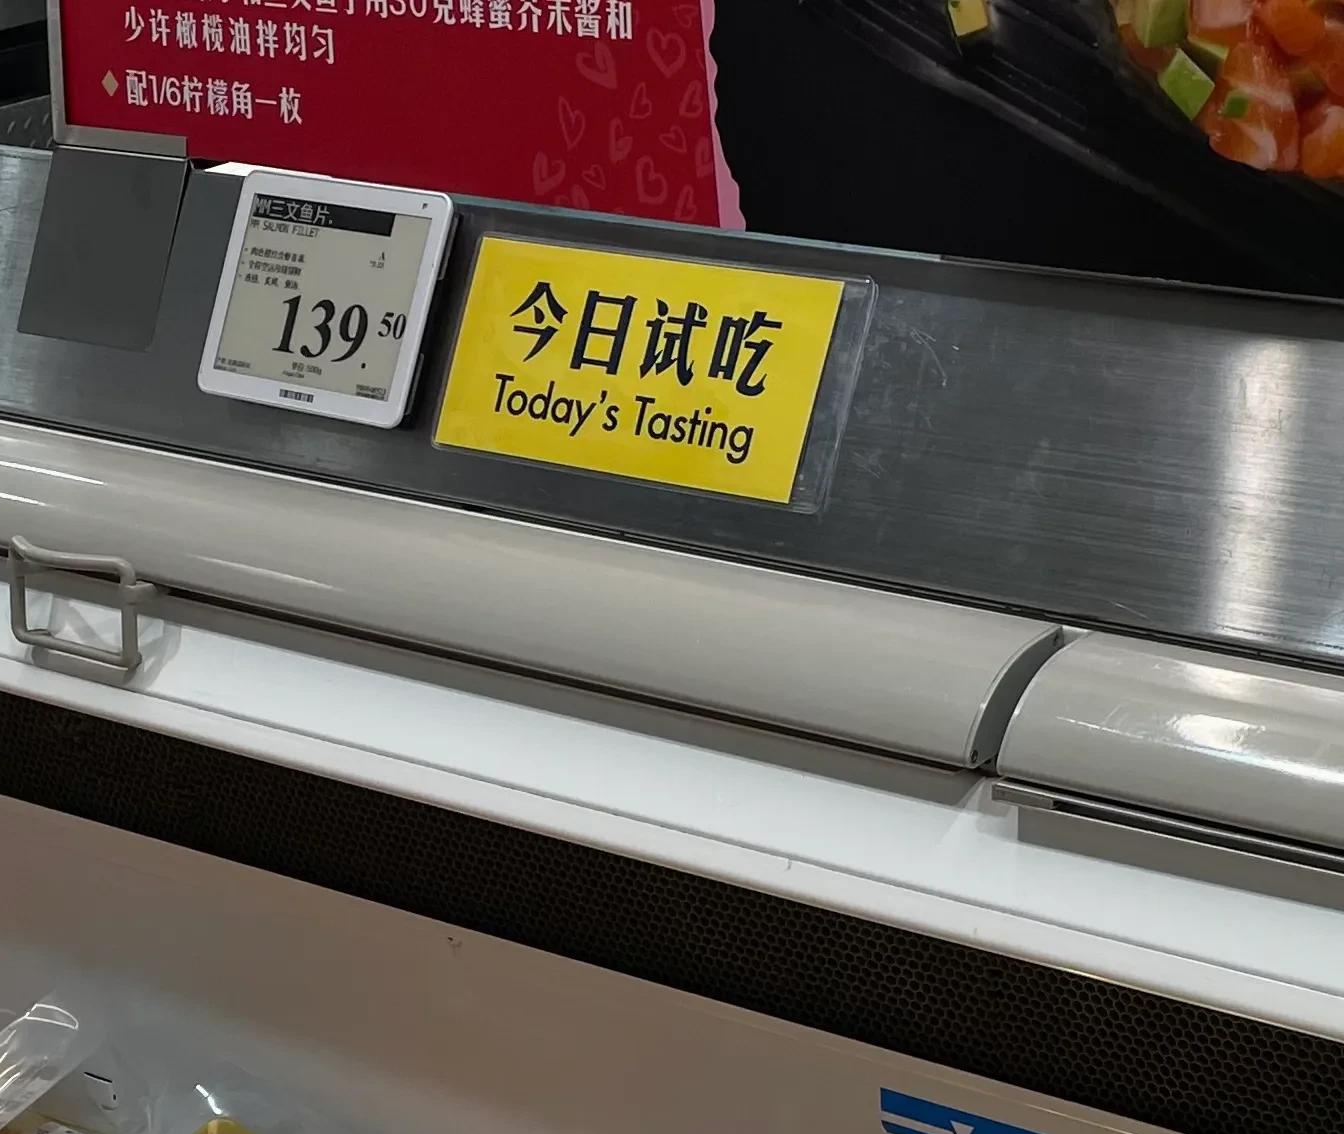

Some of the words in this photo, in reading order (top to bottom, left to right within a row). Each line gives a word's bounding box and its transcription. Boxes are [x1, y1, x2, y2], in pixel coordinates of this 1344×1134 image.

[124, 6, 335, 64] 少许橄榄油拌均匀
[125, 69, 303, 125] 配1/6柠檬角一枚
[510, 281, 783, 397] 今日试吃
[494, 374, 618, 437] Today's
[634, 396, 755, 465] Tasting
